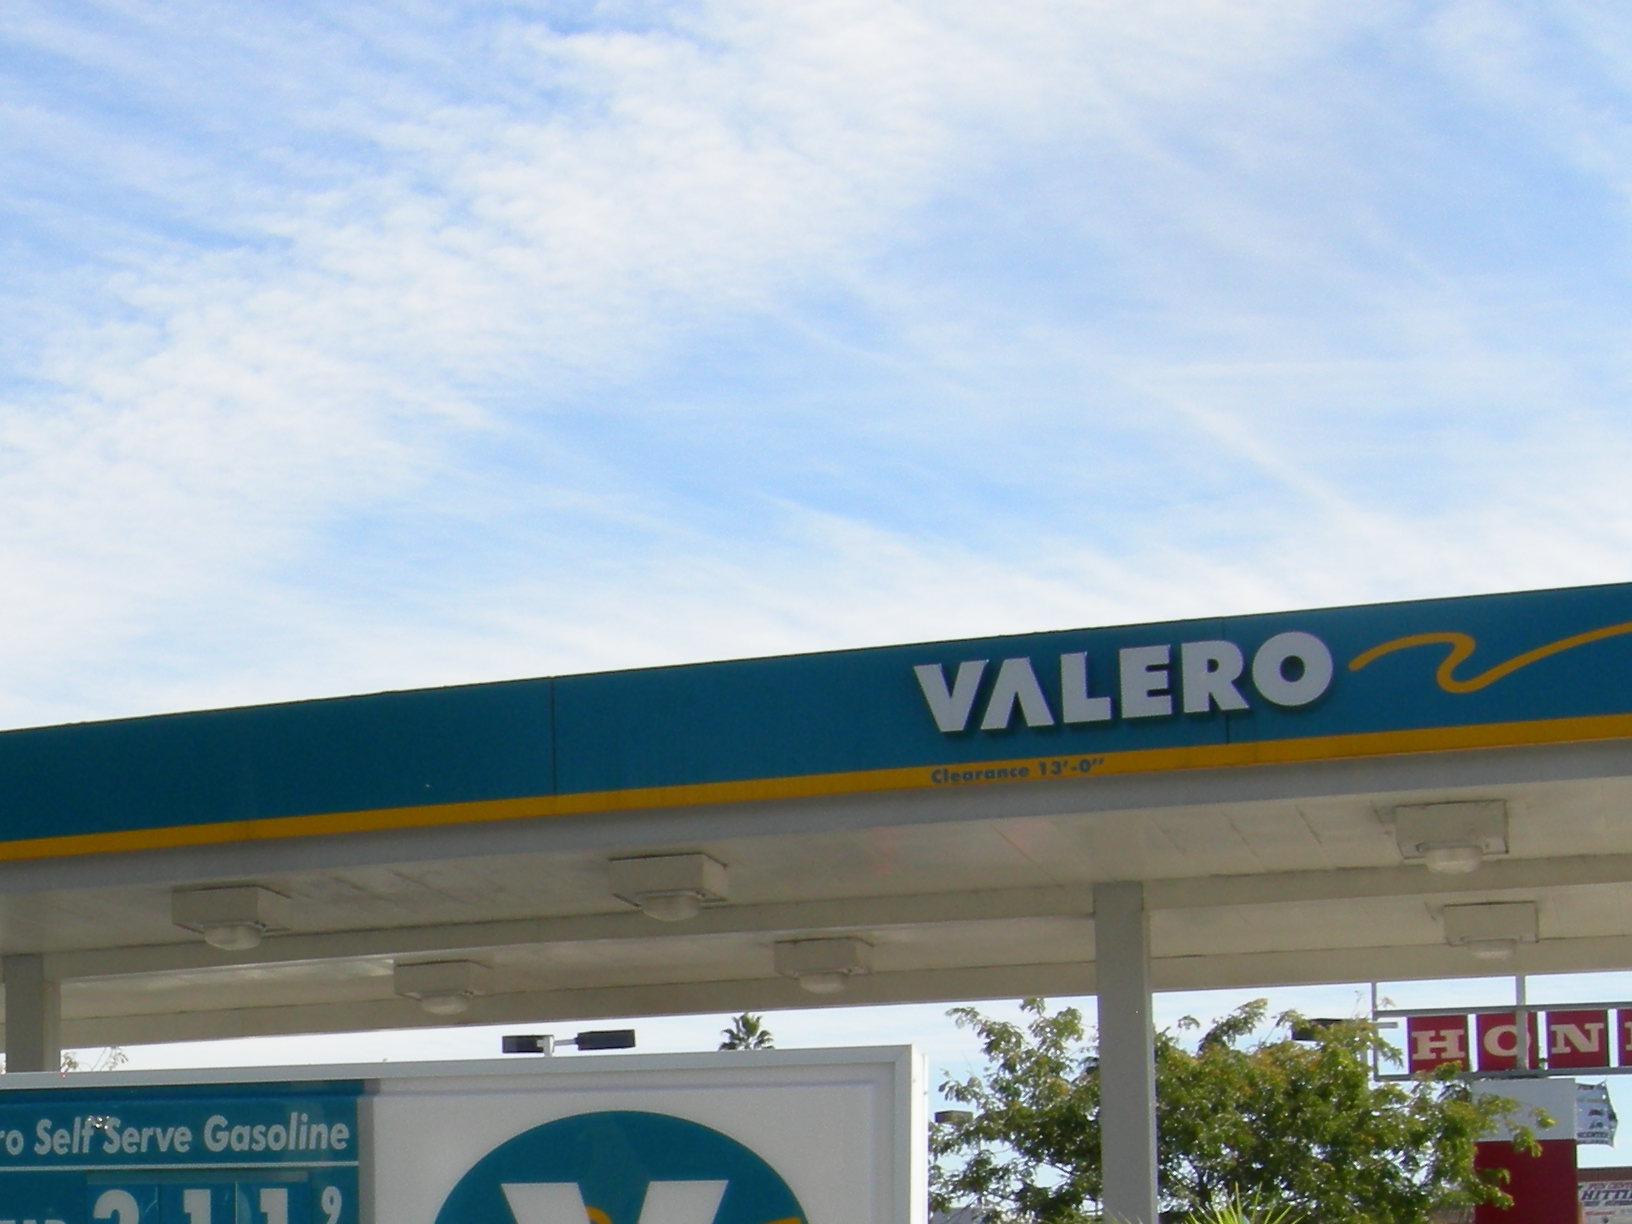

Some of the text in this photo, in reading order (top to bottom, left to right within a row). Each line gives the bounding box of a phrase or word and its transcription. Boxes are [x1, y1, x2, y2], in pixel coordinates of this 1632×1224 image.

[913, 631, 1334, 733] VALERO
[931, 766, 1029, 784] Clearance
[1412, 1021, 1632, 1060] HON
[34, 1118, 94, 1154] Self
[104, 1117, 192, 1154] Serve
[204, 1113, 350, 1152] Gasoline
